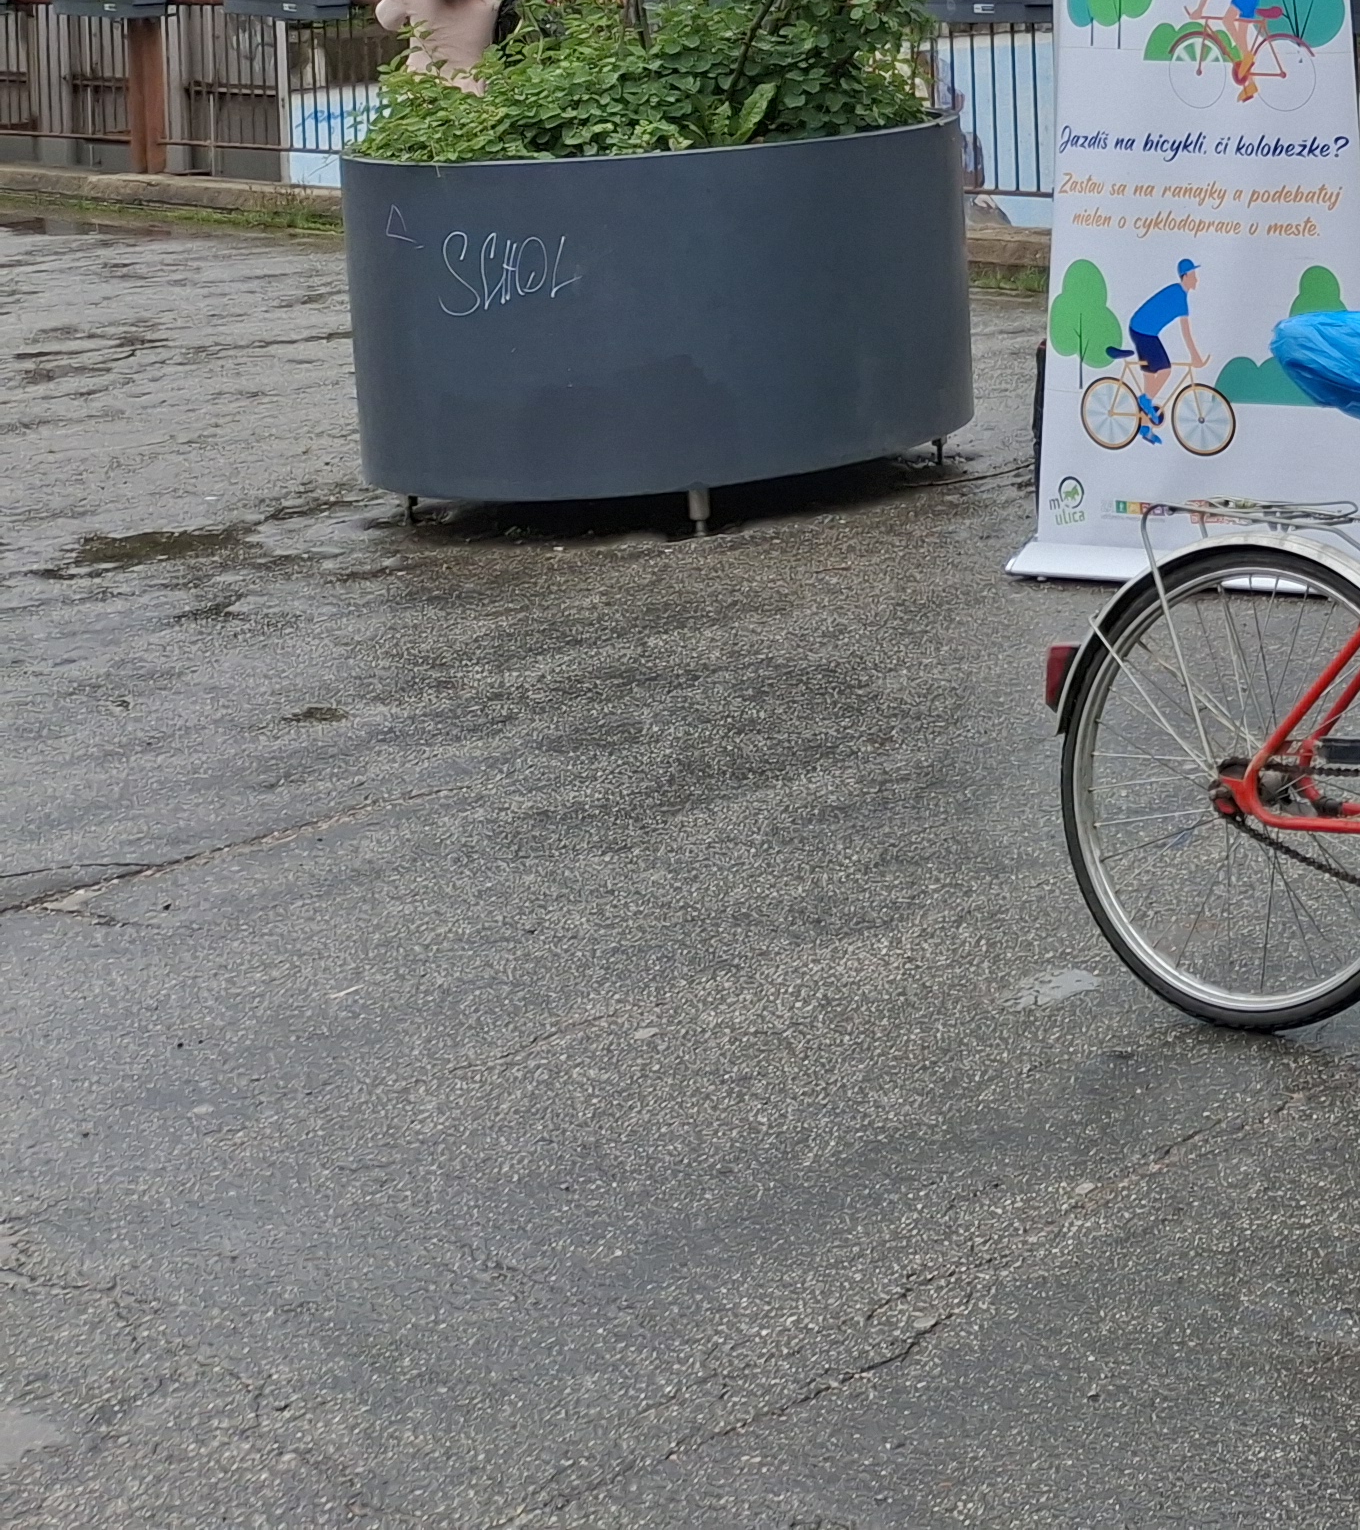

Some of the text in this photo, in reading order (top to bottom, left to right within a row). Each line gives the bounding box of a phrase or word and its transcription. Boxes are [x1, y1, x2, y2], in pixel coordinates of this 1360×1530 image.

[1058, 125, 1110, 155] Jazdíš
[1113, 135, 1136, 151] na
[1213, 137, 1230, 156] či
[1234, 134, 1350, 159] kolobežke?
[1058, 172, 1344, 211] Zastav sa na raňajky a podebatuj
[1072, 207, 1112, 228] nielen
[1117, 215, 1127, 229] o
[1133, 210, 1242, 239] cyklodoprave
[1248, 222, 1259, 236] v
